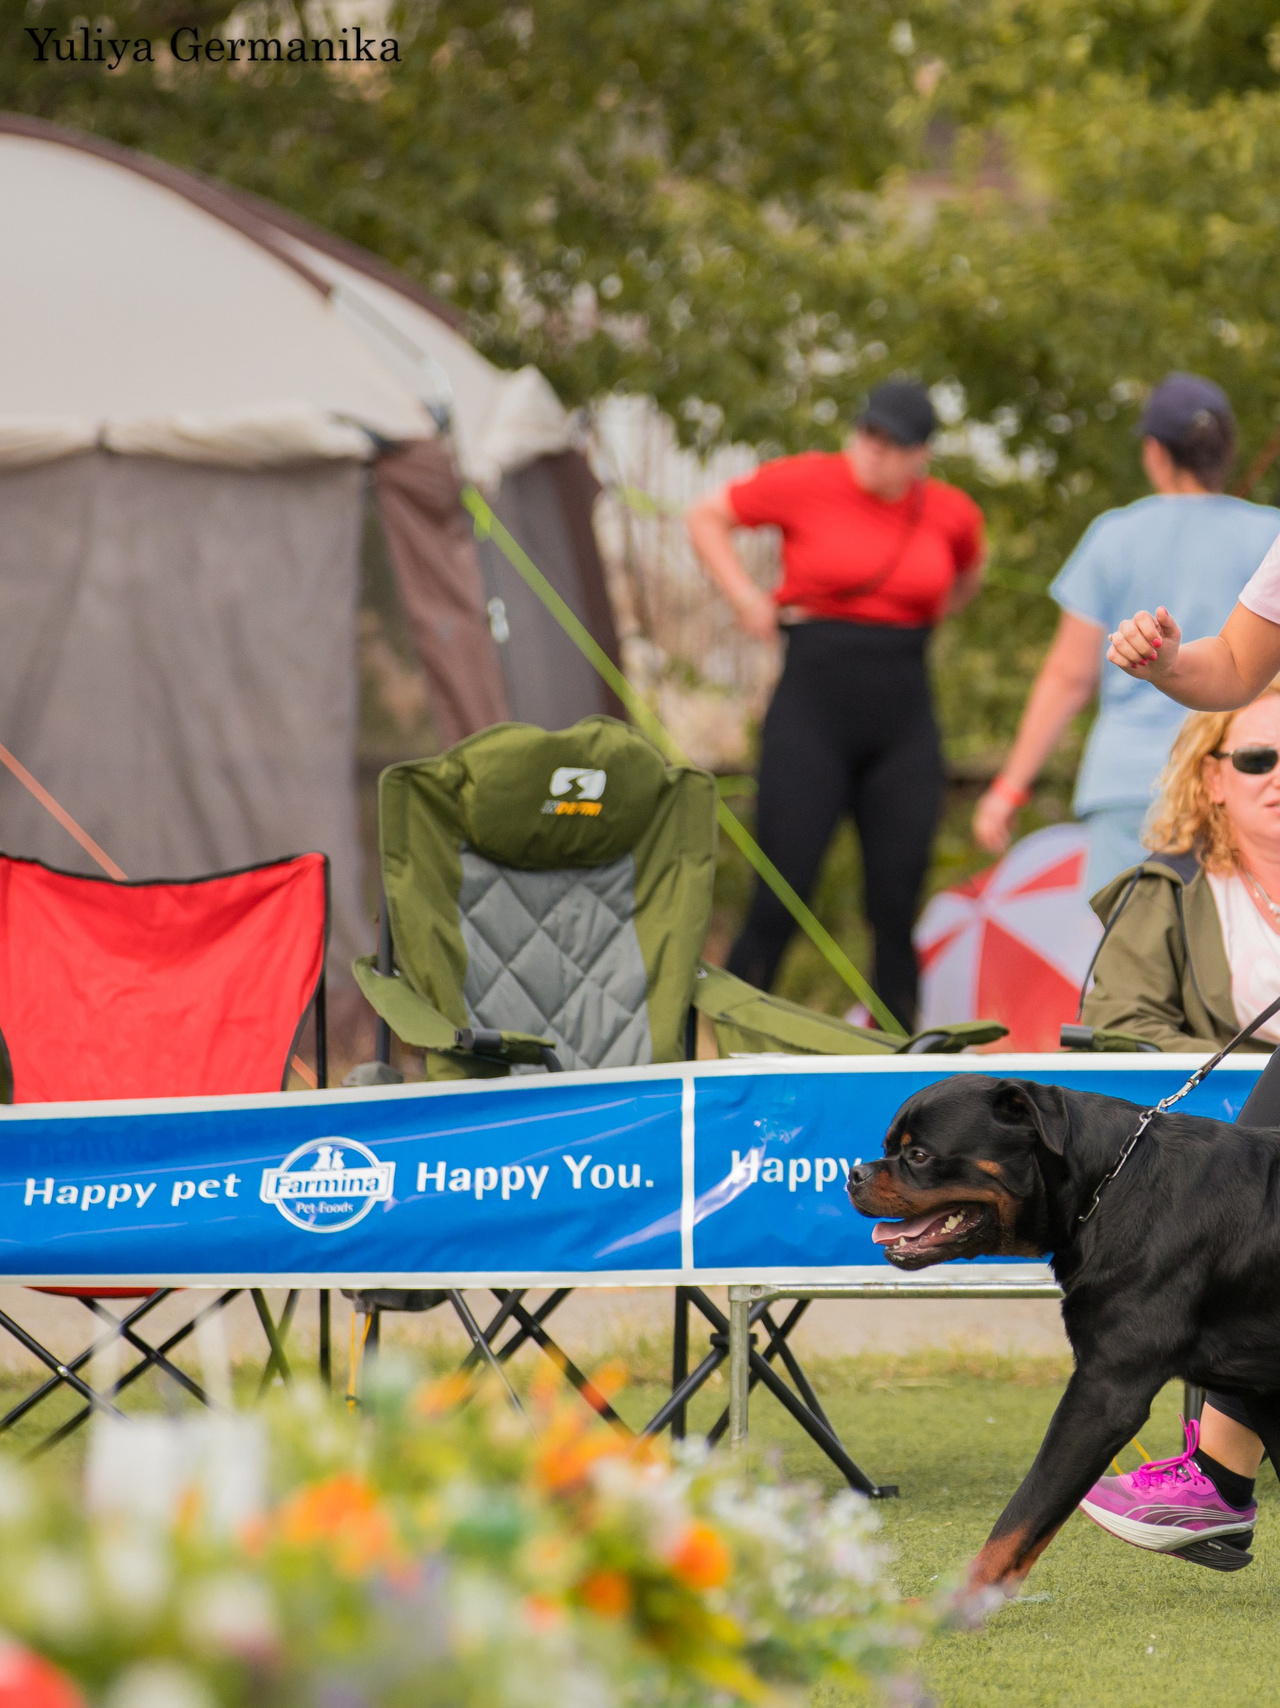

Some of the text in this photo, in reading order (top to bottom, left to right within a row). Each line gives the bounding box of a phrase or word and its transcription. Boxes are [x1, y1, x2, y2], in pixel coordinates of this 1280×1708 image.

[274, 1173, 380, 1194] Farmina
[416, 1154, 654, 1200] Happy You.
[24, 1173, 241, 1211] Happy pet
[296, 1201, 353, 1214] Pet Foods
